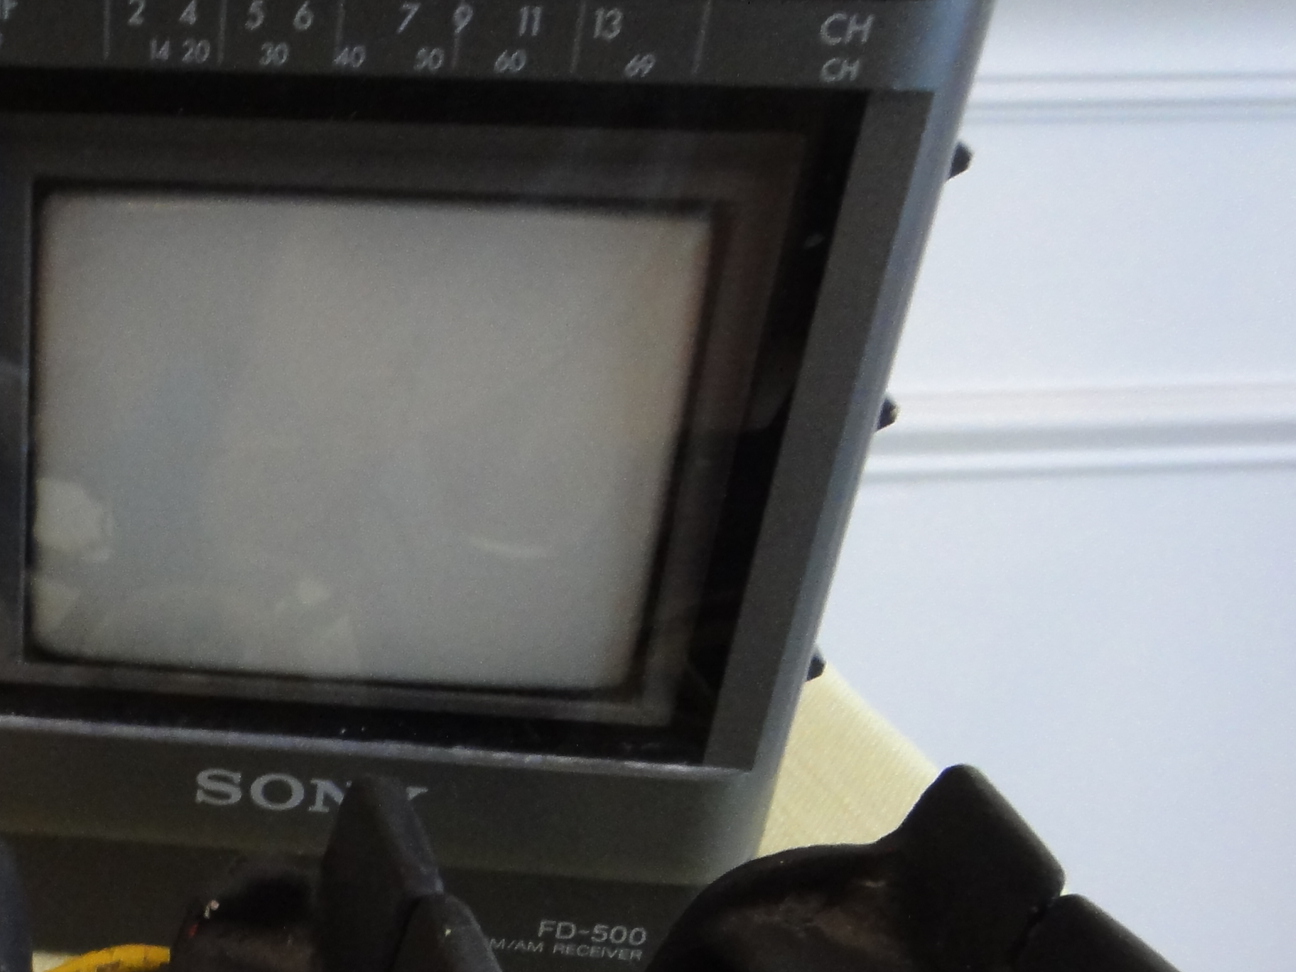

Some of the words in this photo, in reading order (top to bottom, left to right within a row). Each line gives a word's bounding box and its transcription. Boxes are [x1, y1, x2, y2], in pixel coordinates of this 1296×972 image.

[128, 0, 146, 26] 2
[178, 0, 198, 26] 4
[244, 1, 265, 31] 5
[292, 4, 314, 31] 6
[396, 2, 418, 34] 7
[453, 3, 473, 34] 9
[518, 6, 541, 36] 11
[593, 8, 623, 39] 13
[820, 12, 875, 46] CH
[149, 38, 171, 61] 14
[181, 38, 210, 64] 20
[259, 41, 290, 66] 30
[333, 44, 366, 68] 40
[494, 49, 527, 74] 60
[820, 57, 861, 82] CH
[195, 767, 429, 813] SON
[537, 919, 647, 946] FD-500
[552, 943, 643, 962] RECEIVER
